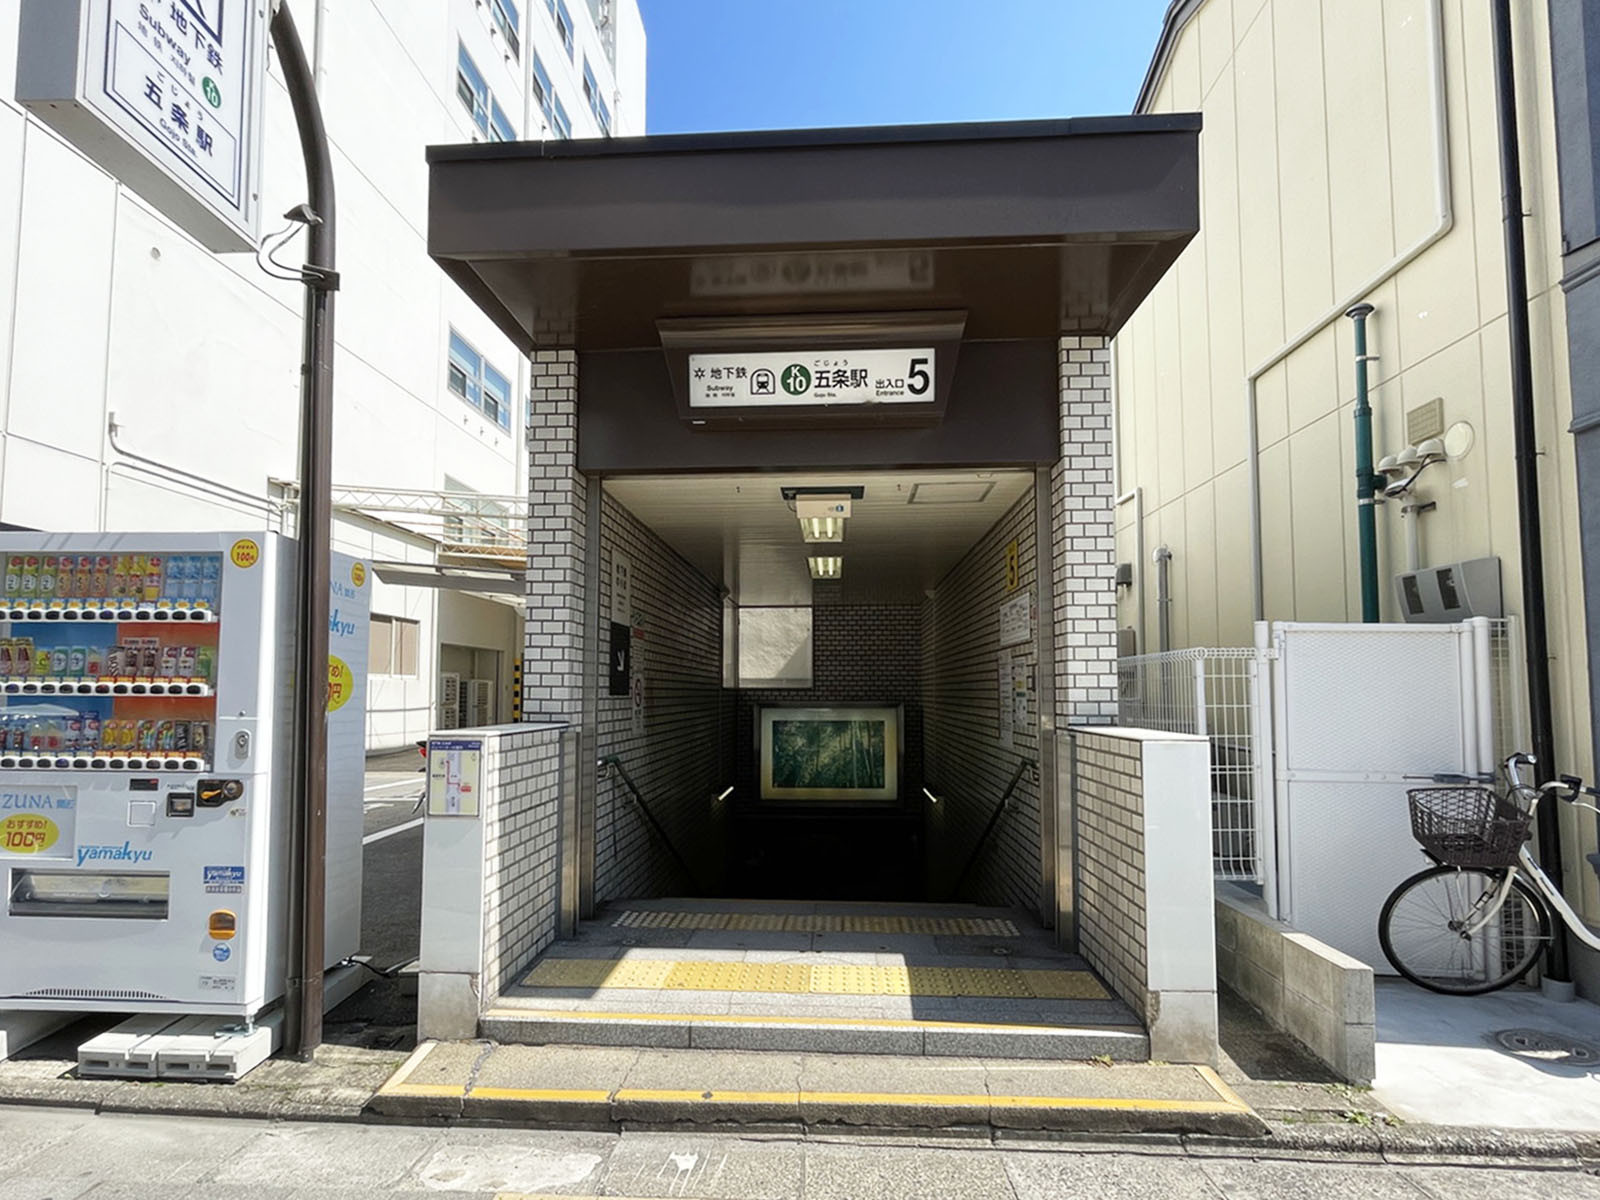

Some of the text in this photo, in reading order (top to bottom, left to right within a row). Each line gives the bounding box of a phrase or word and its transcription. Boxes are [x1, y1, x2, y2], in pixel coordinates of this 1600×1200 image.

[139, 3, 191, 66] Subway
[170, 1, 223, 76] 地下鉄
[143, 75, 213, 157] 五条駅
[790, 366, 801, 376] K
[814, 359, 849, 367] ごじょう
[710, 366, 748, 380] 地下鉄
[814, 368, 869, 390] 五条駅
[907, 357, 931, 396] 5
[706, 384, 734, 392] Subway
[787, 375, 807, 392] 10
[875, 378, 905, 390] 出入口
[876, 389, 905, 397] Entrance
[0, 793, 53, 809] ZUNA
[5, 831, 46, 848] 100円
[77, 840, 153, 867] yamakyu
